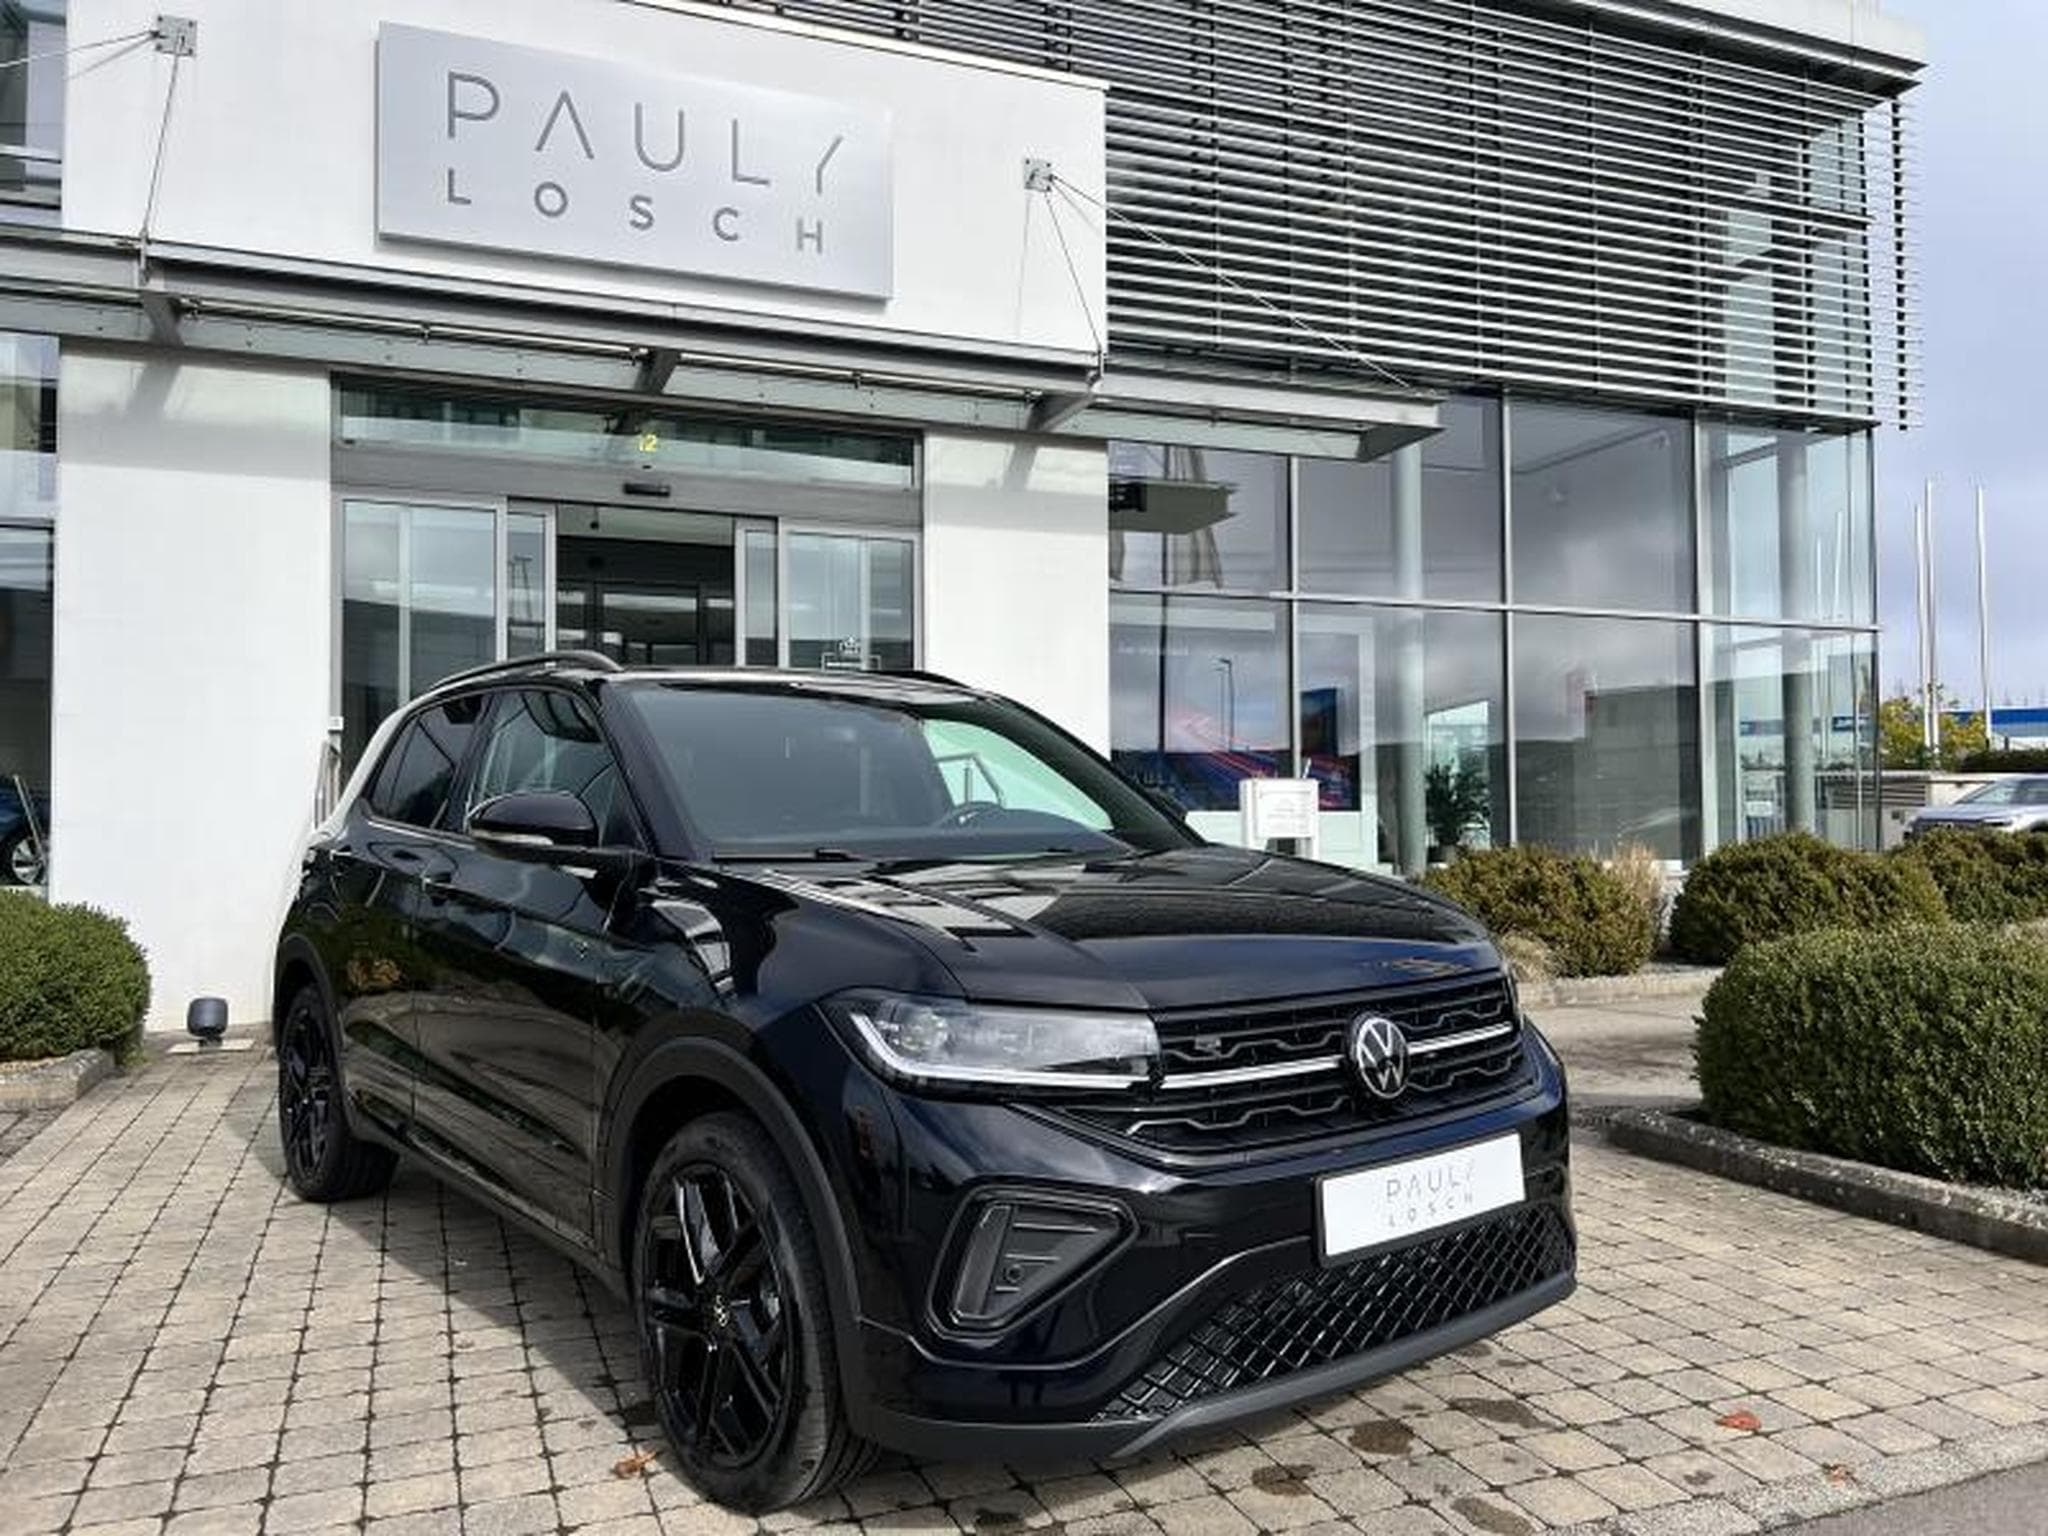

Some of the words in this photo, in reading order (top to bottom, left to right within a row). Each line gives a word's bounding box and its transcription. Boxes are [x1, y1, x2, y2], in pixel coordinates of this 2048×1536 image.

[447, 70, 843, 194] PAULY
[447, 167, 823, 254] LOSCH
[1386, 1158, 1474, 1203] PAULY
[1389, 1192, 1473, 1227] LOSCH
